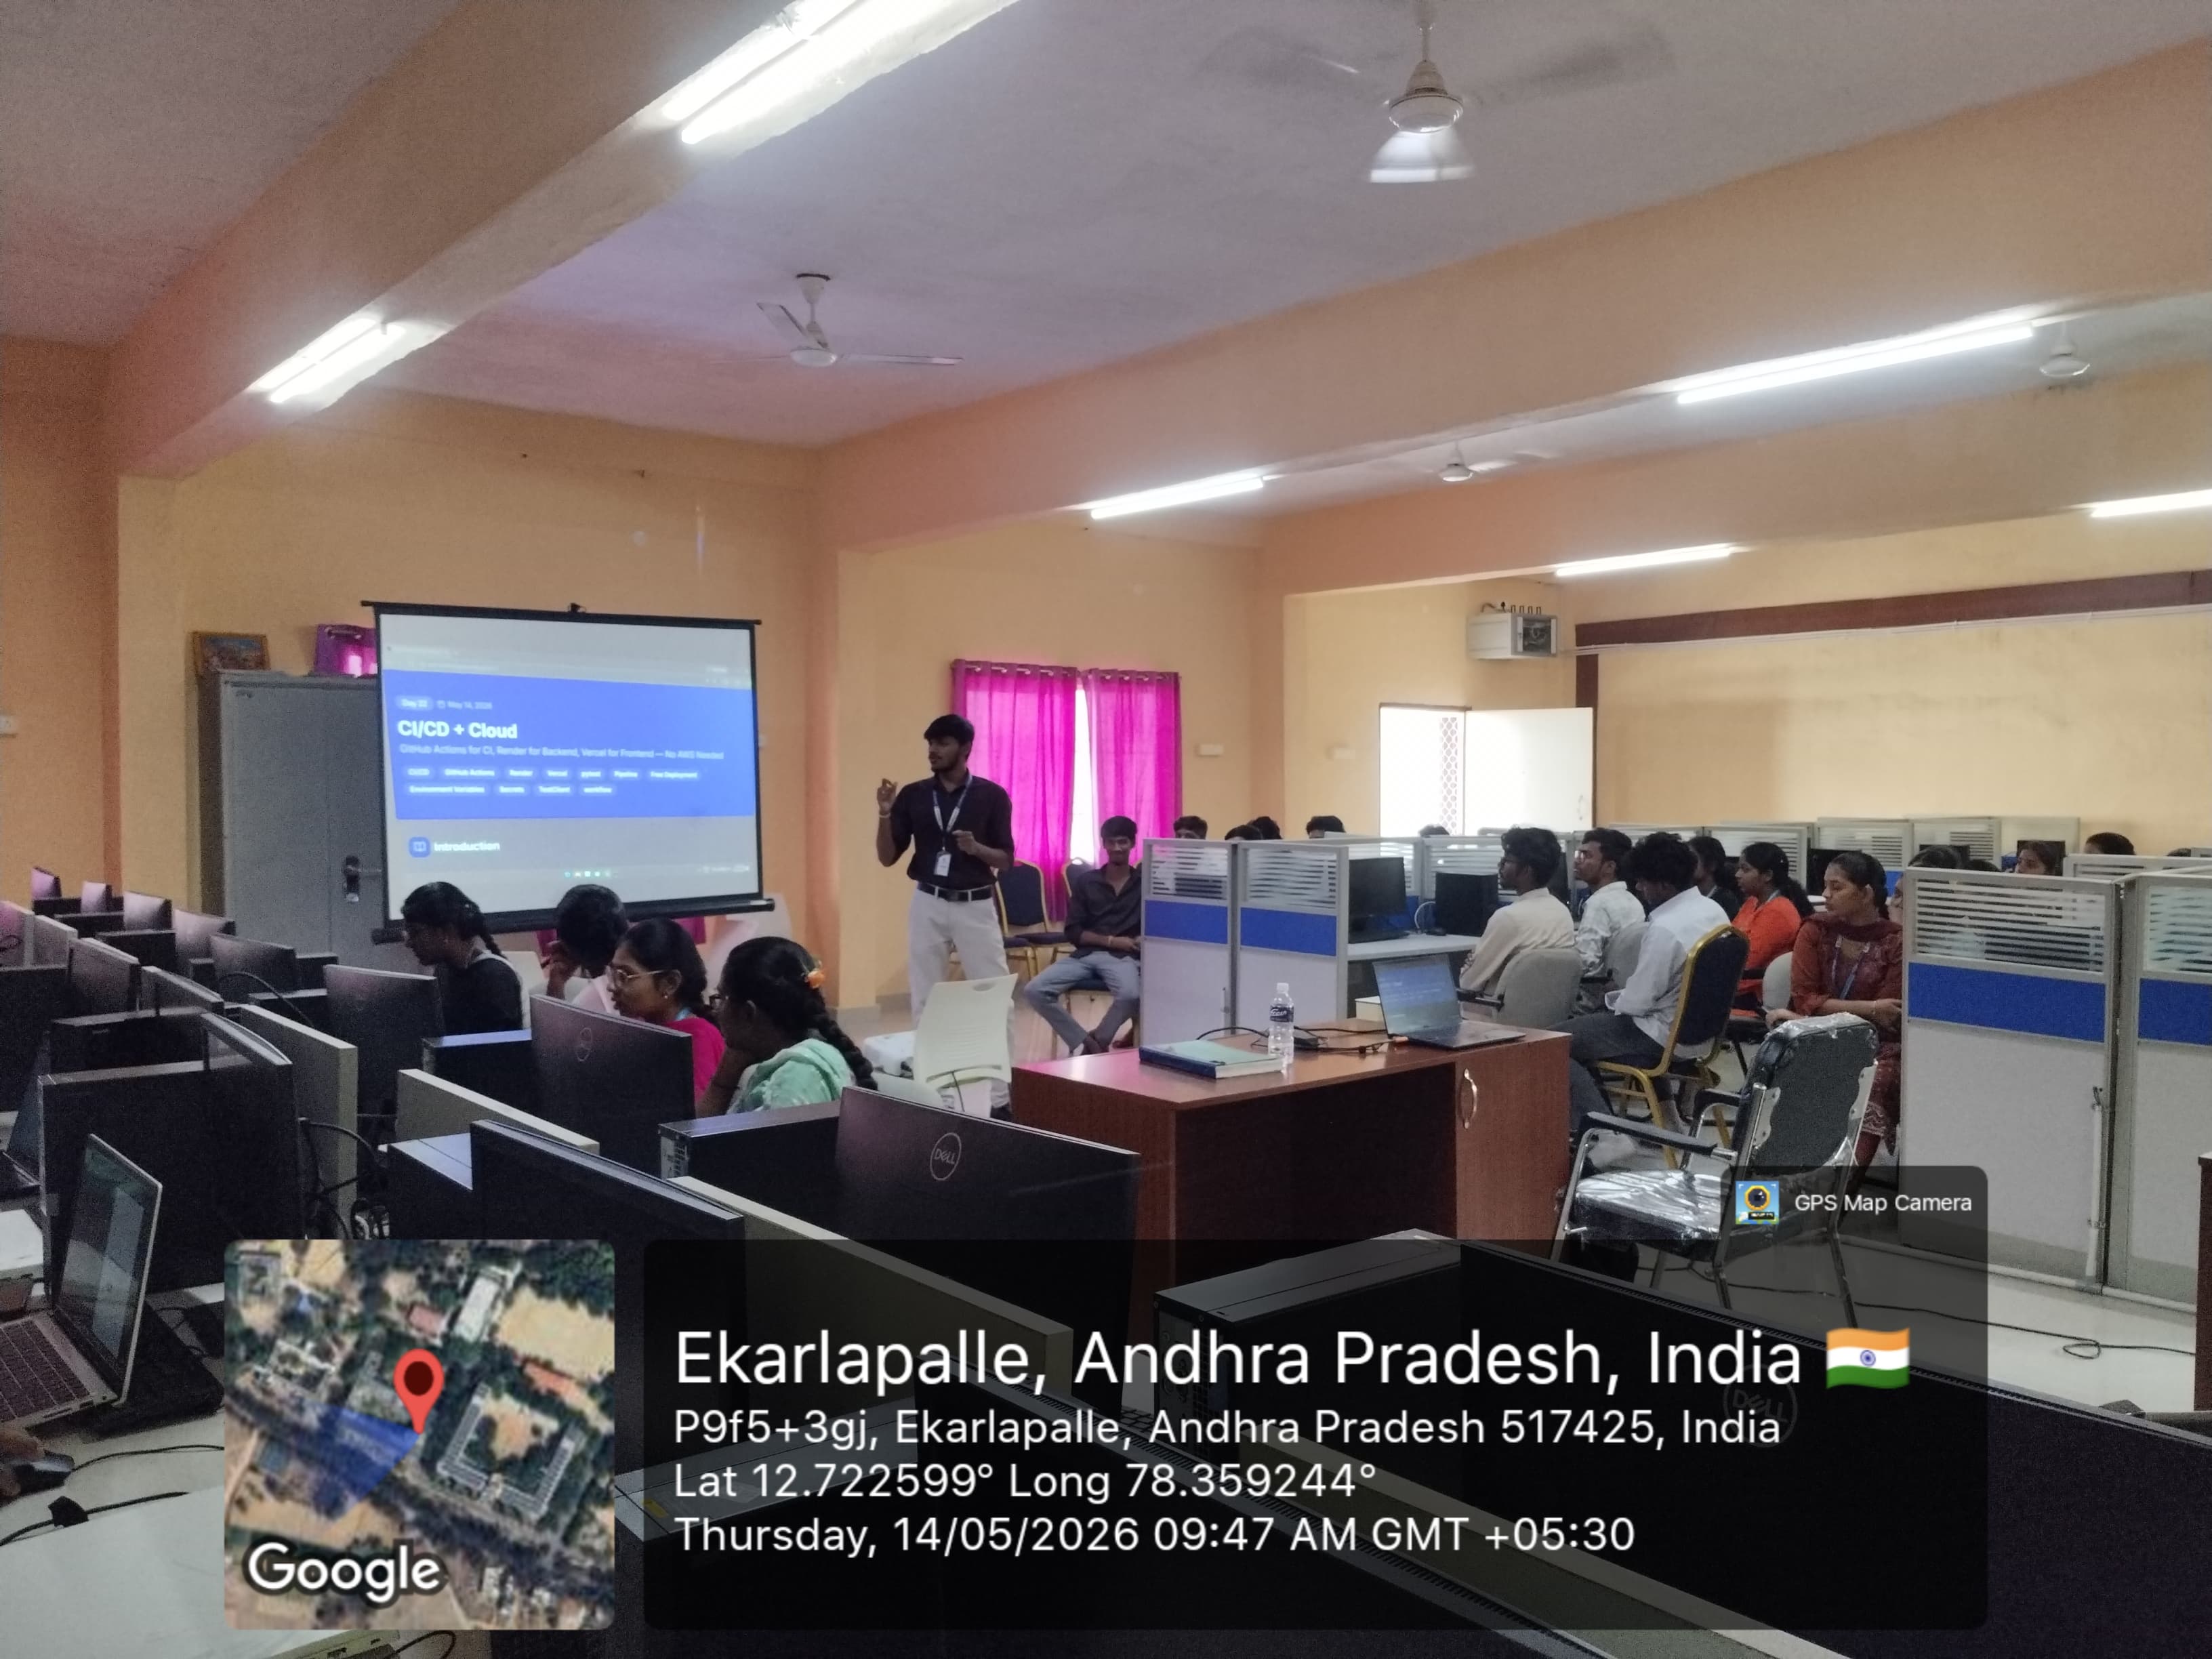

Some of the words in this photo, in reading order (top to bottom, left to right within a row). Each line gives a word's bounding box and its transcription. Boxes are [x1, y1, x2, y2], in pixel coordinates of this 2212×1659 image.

[397, 720, 450, 739] CI/CD
[453, 724, 465, 735] +
[468, 722, 518, 739] Cloud
[434, 744, 468, 754] Actions
[468, 745, 481, 754] for
[528, 745, 541, 756] for
[607, 748, 619, 757] for
[433, 840, 501, 852] Introduction
[935, 1148, 956, 1165] DELL
